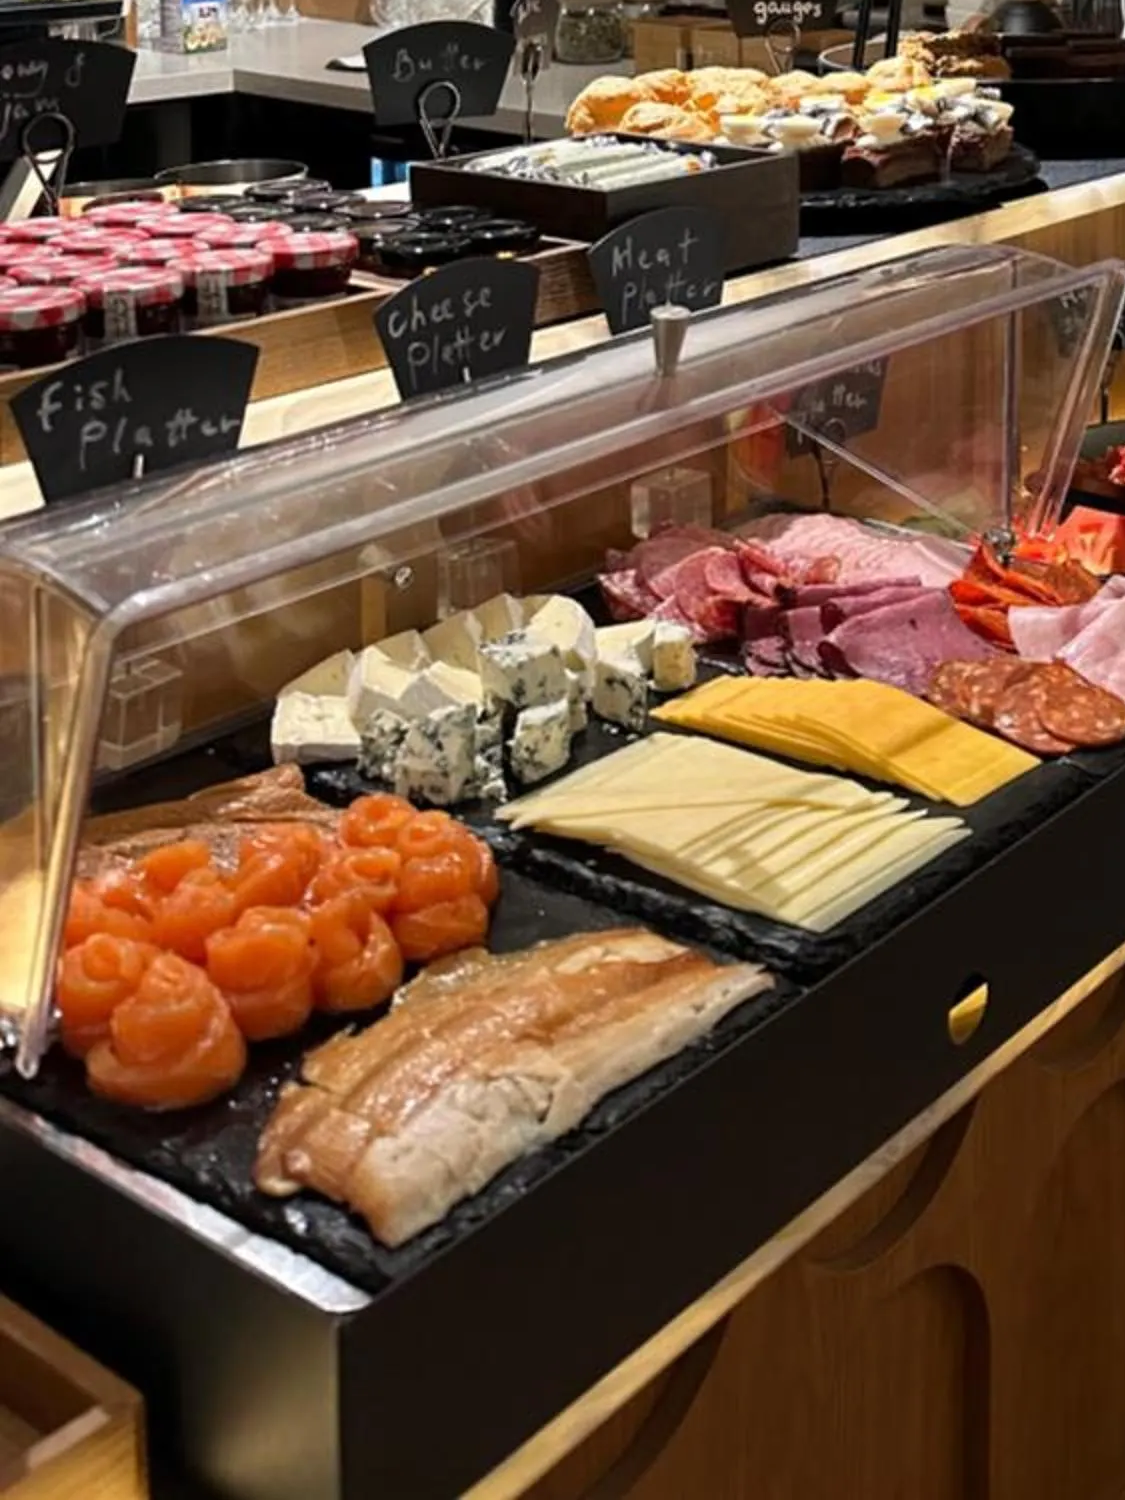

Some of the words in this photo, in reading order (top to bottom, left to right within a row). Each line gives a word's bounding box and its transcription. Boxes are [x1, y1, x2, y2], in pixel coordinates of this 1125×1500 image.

[0, 60, 49, 98] oney
[392, 42, 486, 83] Butter
[612, 227, 700, 277] Meat
